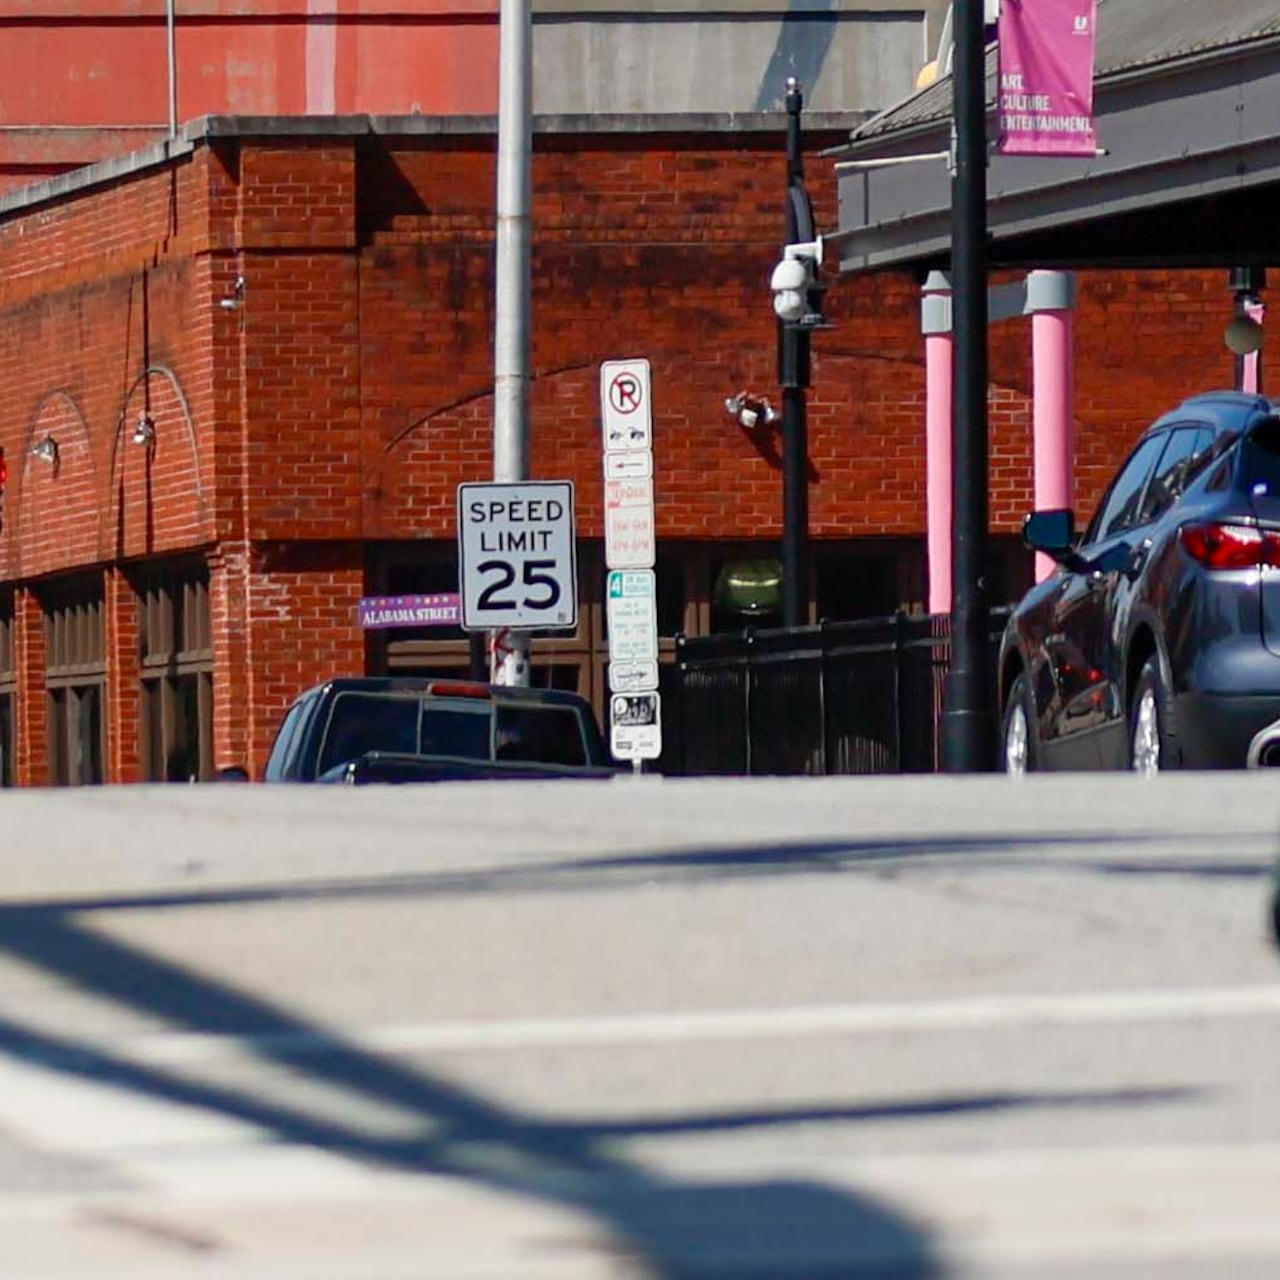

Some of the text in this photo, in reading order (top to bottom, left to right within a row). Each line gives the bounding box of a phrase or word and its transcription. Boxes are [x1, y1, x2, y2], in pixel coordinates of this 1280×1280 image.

[470, 500, 564, 523] SPEED
[480, 530, 553, 552] LIMIT
[476, 560, 561, 611] 25
[363, 607, 458, 625] ALABAMA STREET
